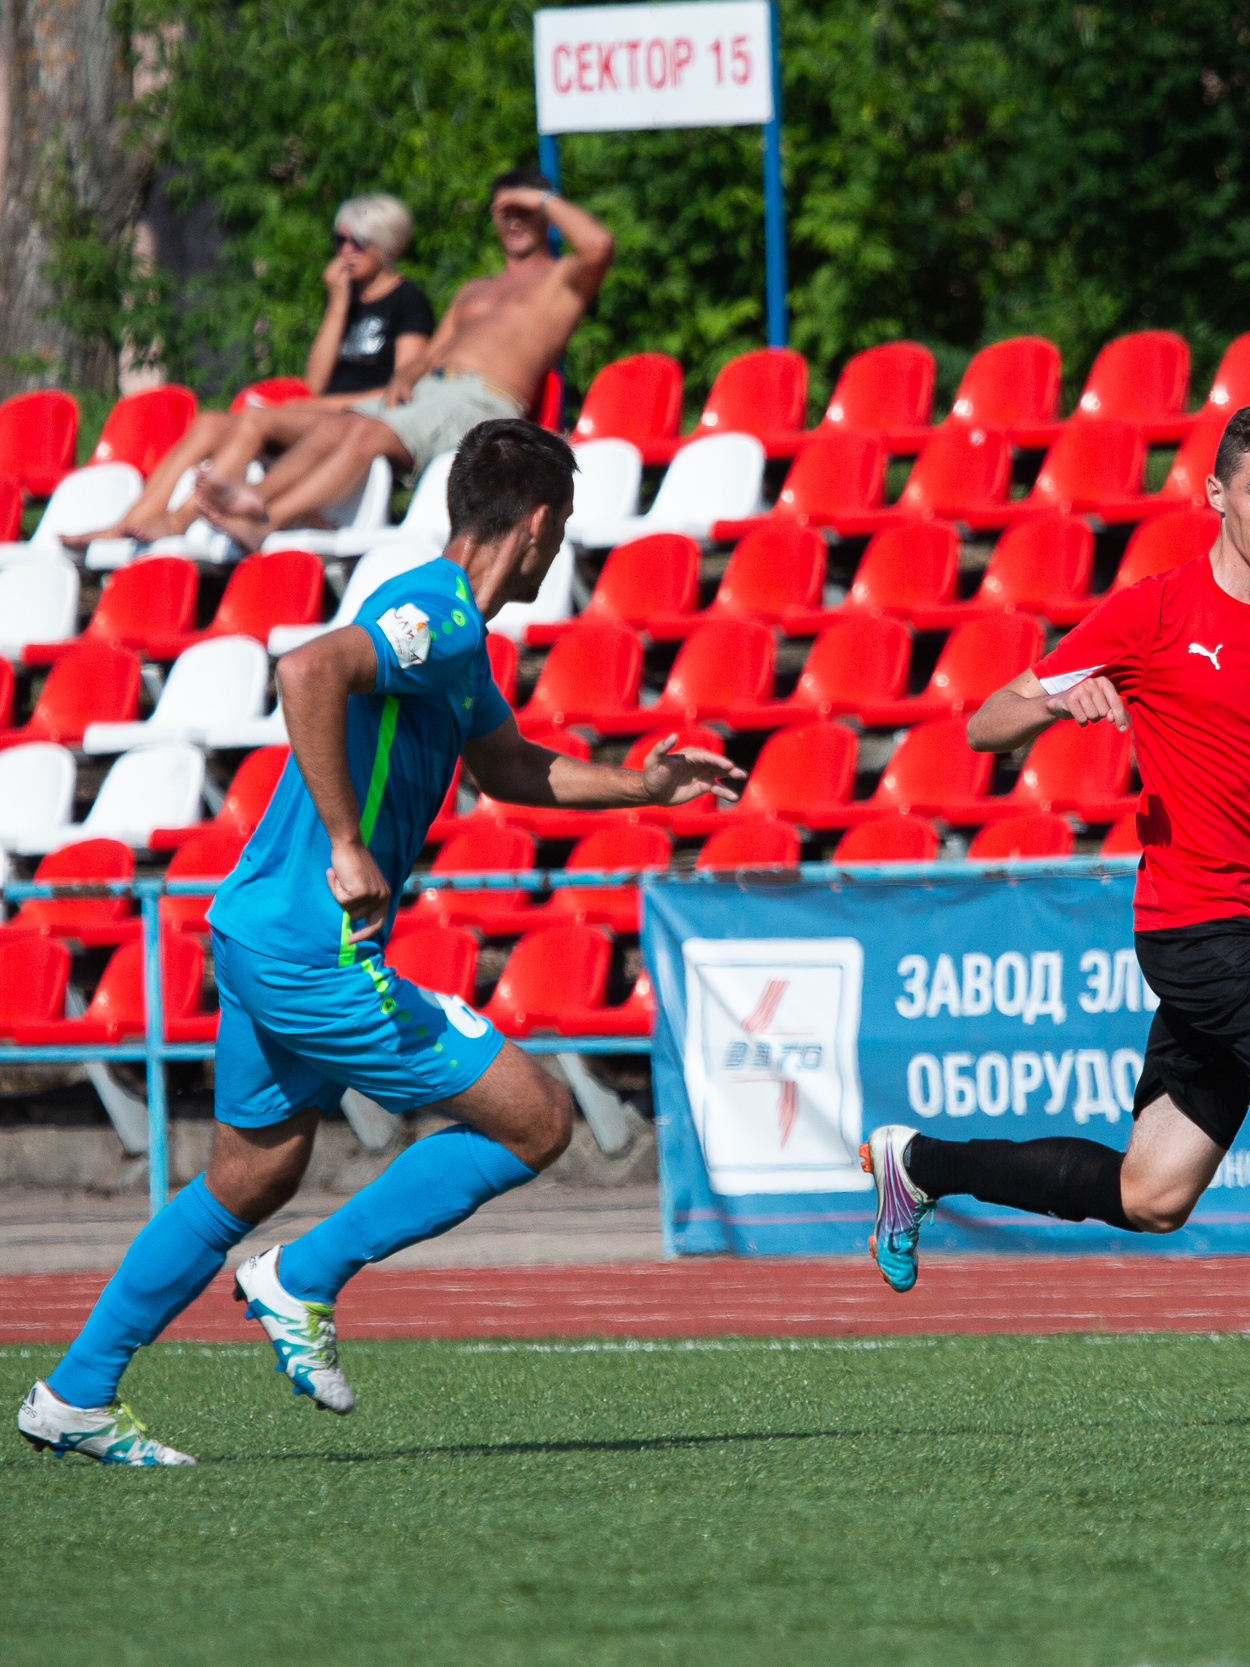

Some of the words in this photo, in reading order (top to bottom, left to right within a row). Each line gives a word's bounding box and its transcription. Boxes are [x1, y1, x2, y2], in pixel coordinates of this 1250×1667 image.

[553, 37, 694, 94] СЕКТОР
[709, 34, 751, 85] 15
[895, 950, 1067, 1025] ЗАВОД
